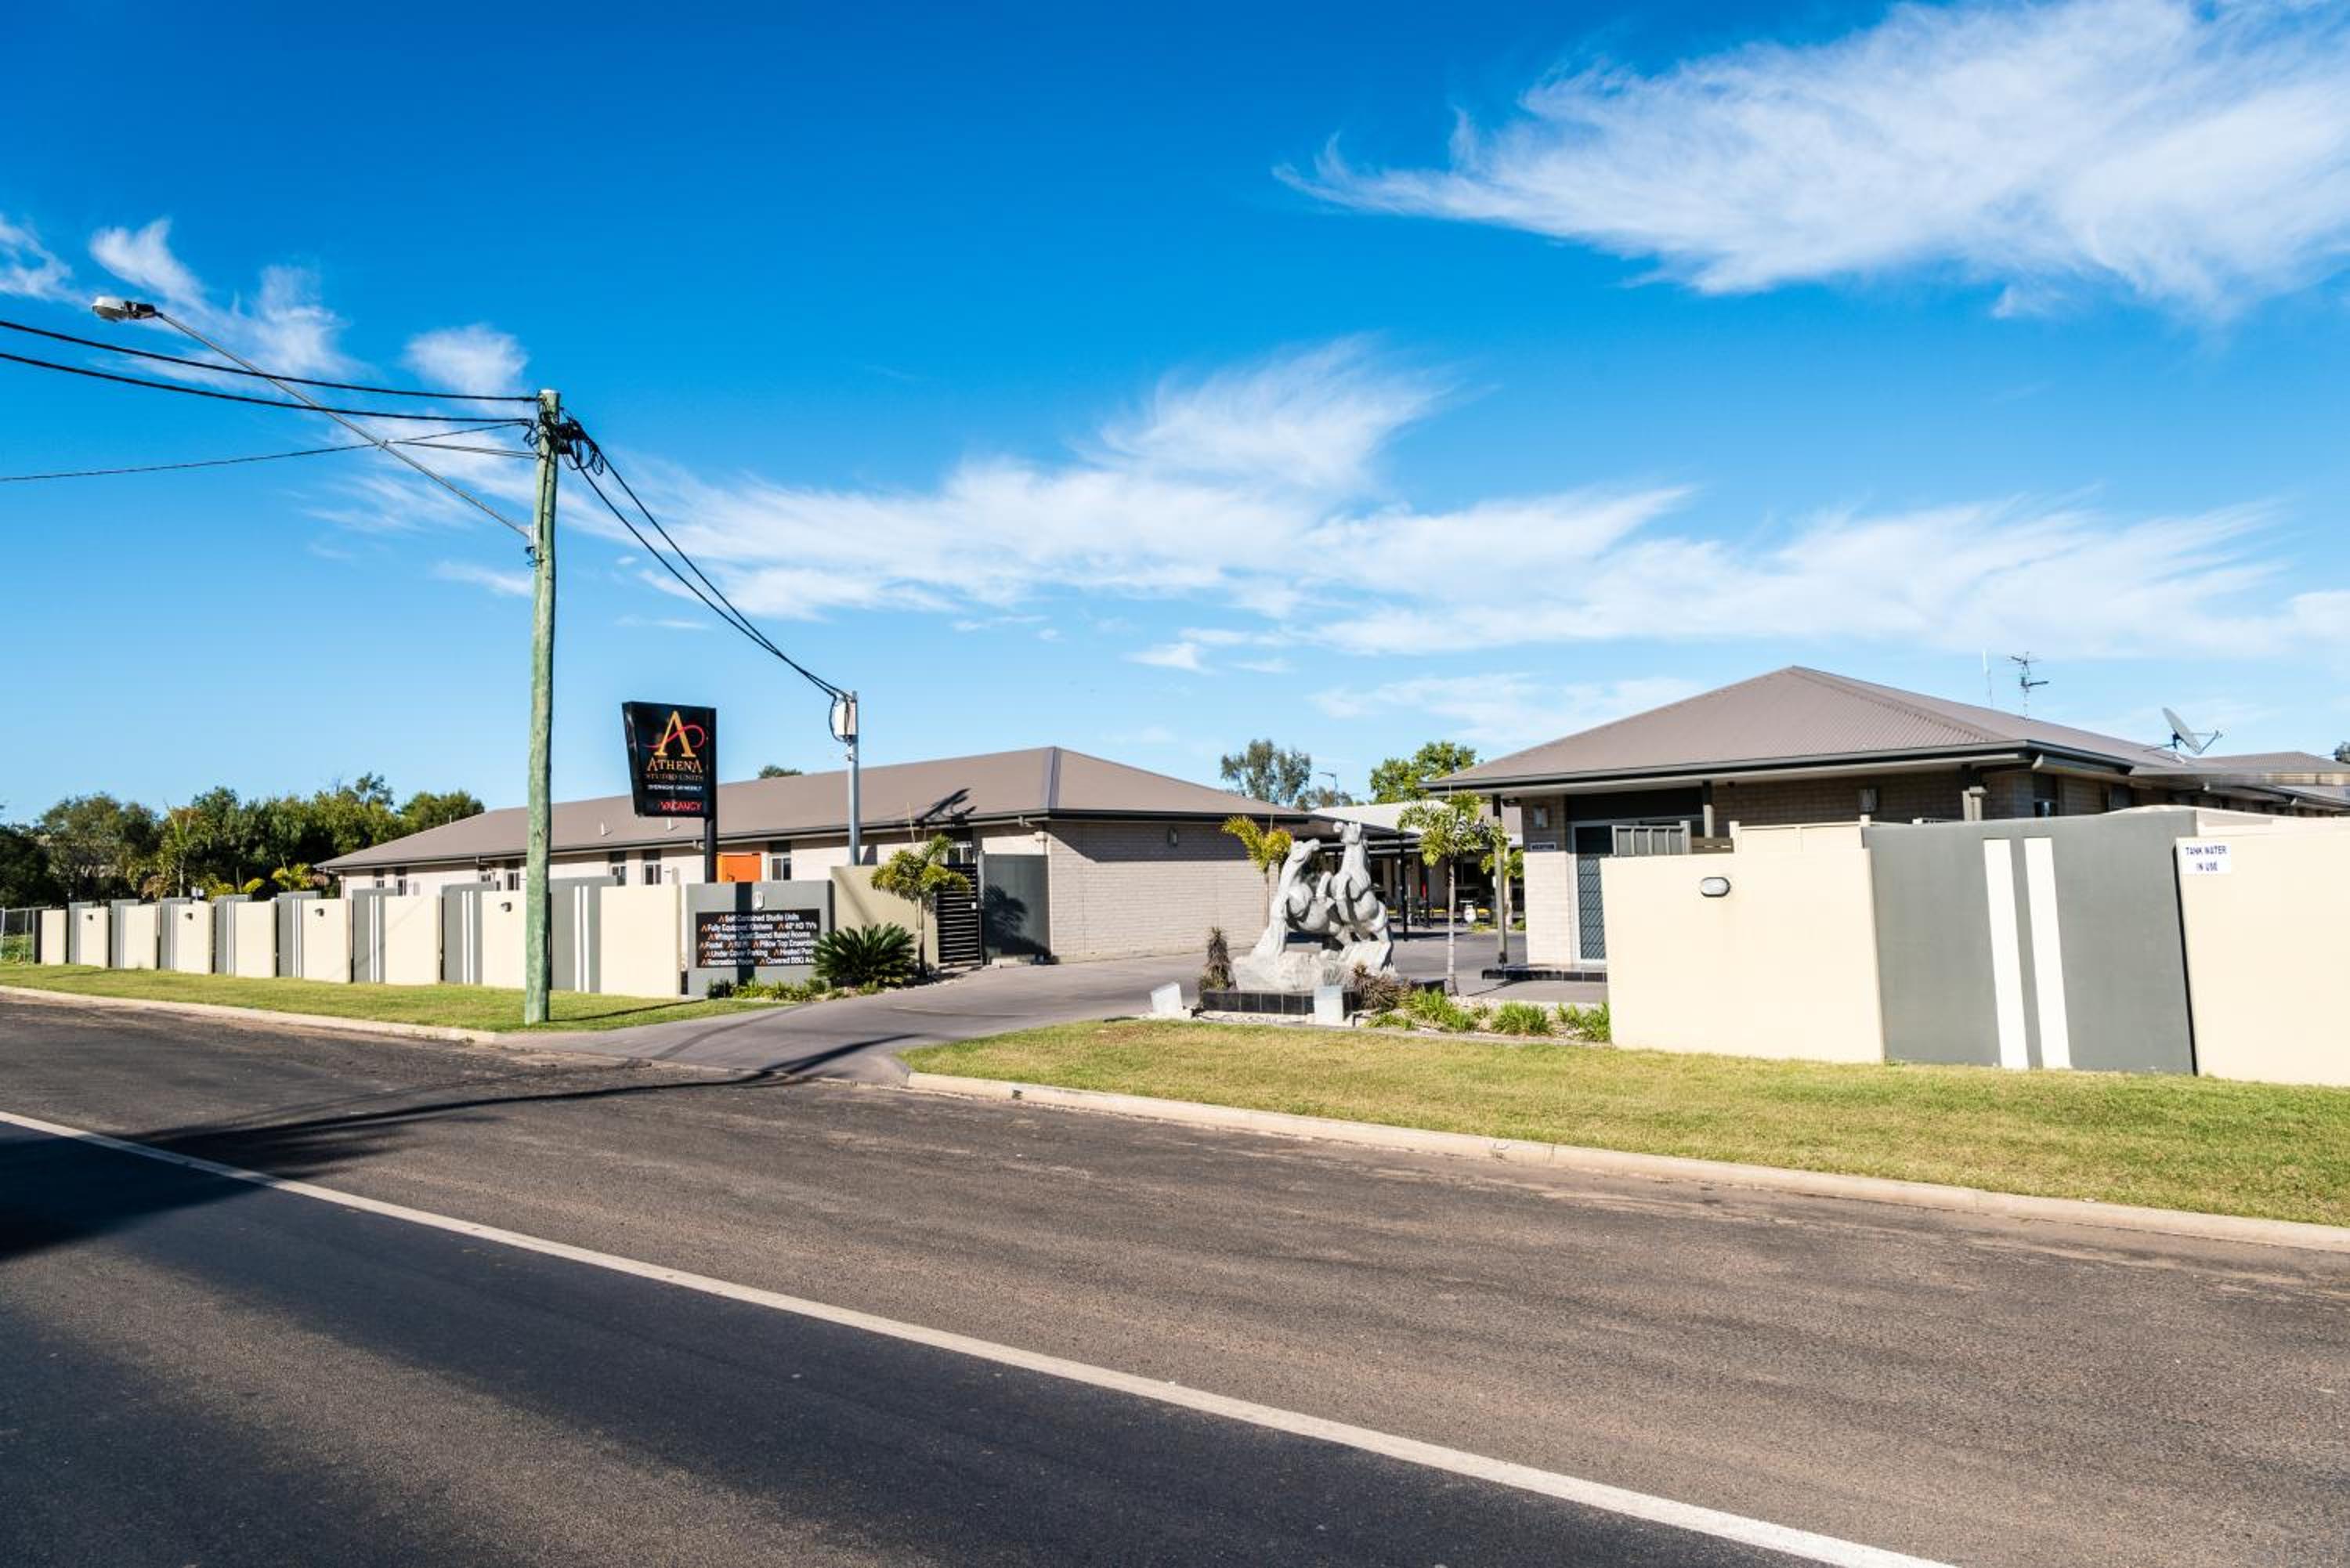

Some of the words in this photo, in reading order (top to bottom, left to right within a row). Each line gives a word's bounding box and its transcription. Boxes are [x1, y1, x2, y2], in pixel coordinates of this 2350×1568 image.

[647, 757, 703, 773] ATHENA
[660, 800, 702, 812] VACANCY
[2186, 847, 2202, 855] TANK
[2205, 845, 2226, 854] WATER
